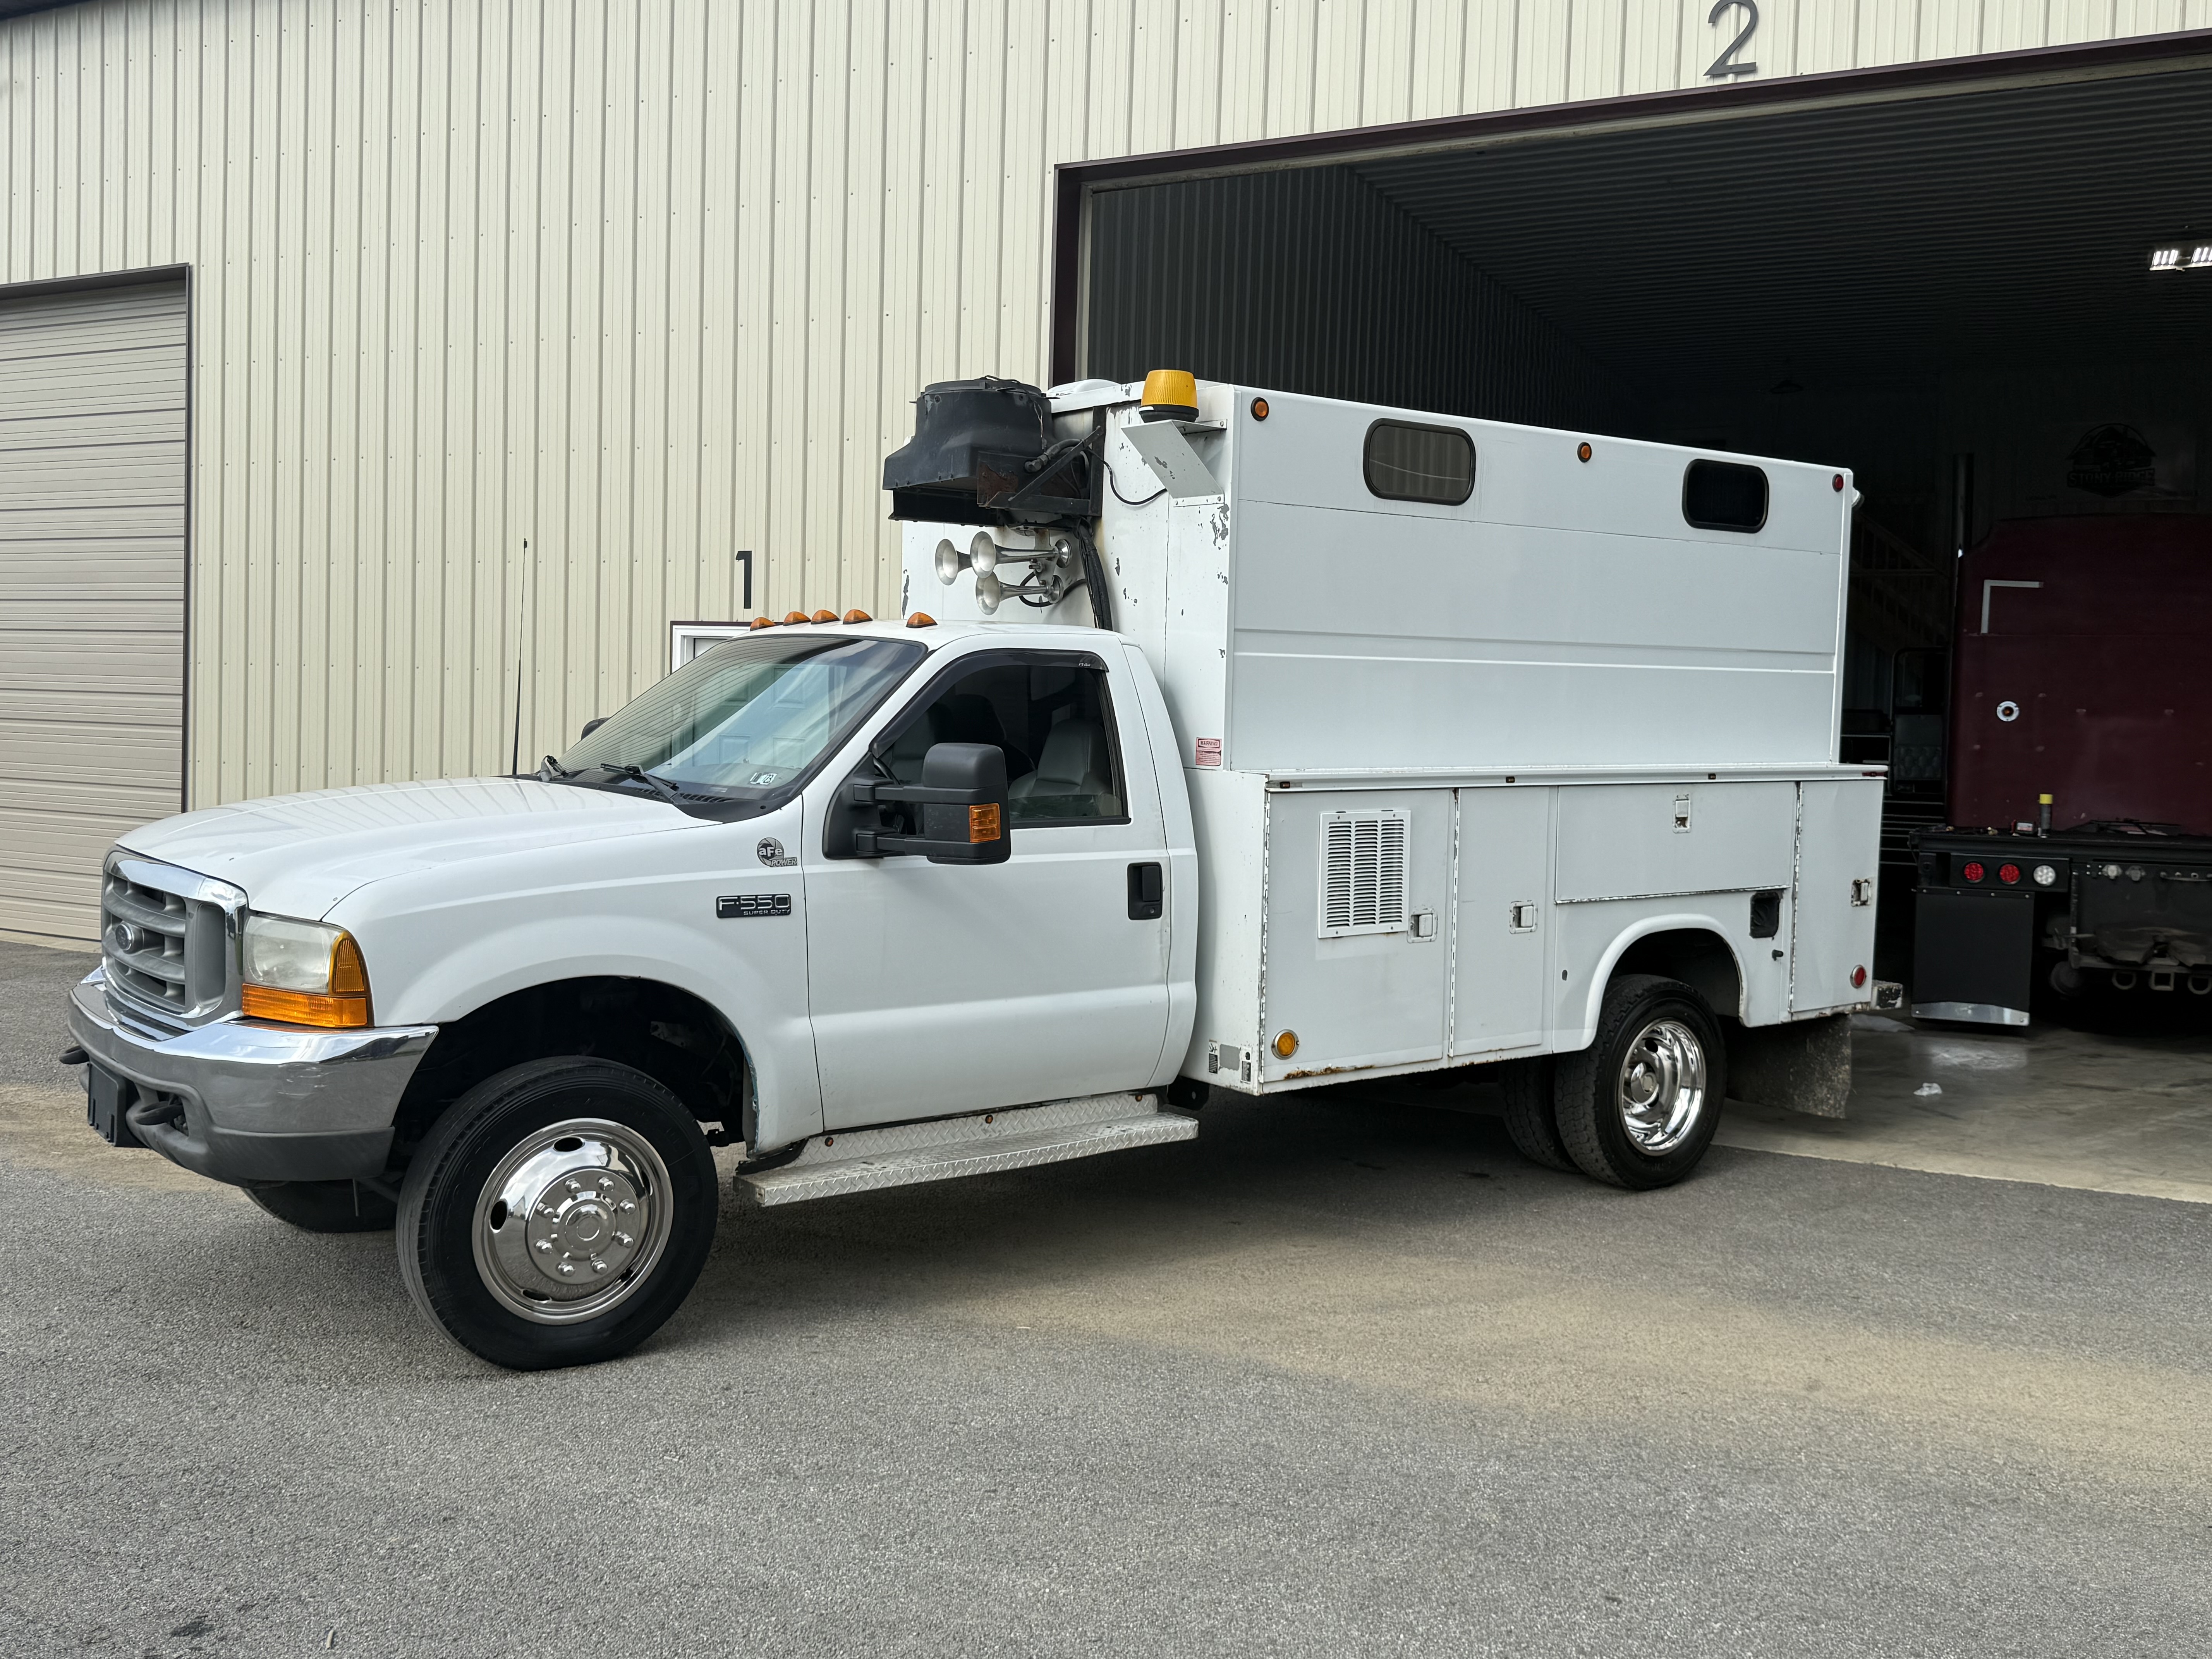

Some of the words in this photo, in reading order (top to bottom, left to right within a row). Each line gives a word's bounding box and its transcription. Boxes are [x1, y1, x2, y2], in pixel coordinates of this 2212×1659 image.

[1703, 0, 1758, 76] 2
[736, 551, 752, 609] 1
[759, 847, 783, 857] aFe
[771, 858, 797, 867] POWER
